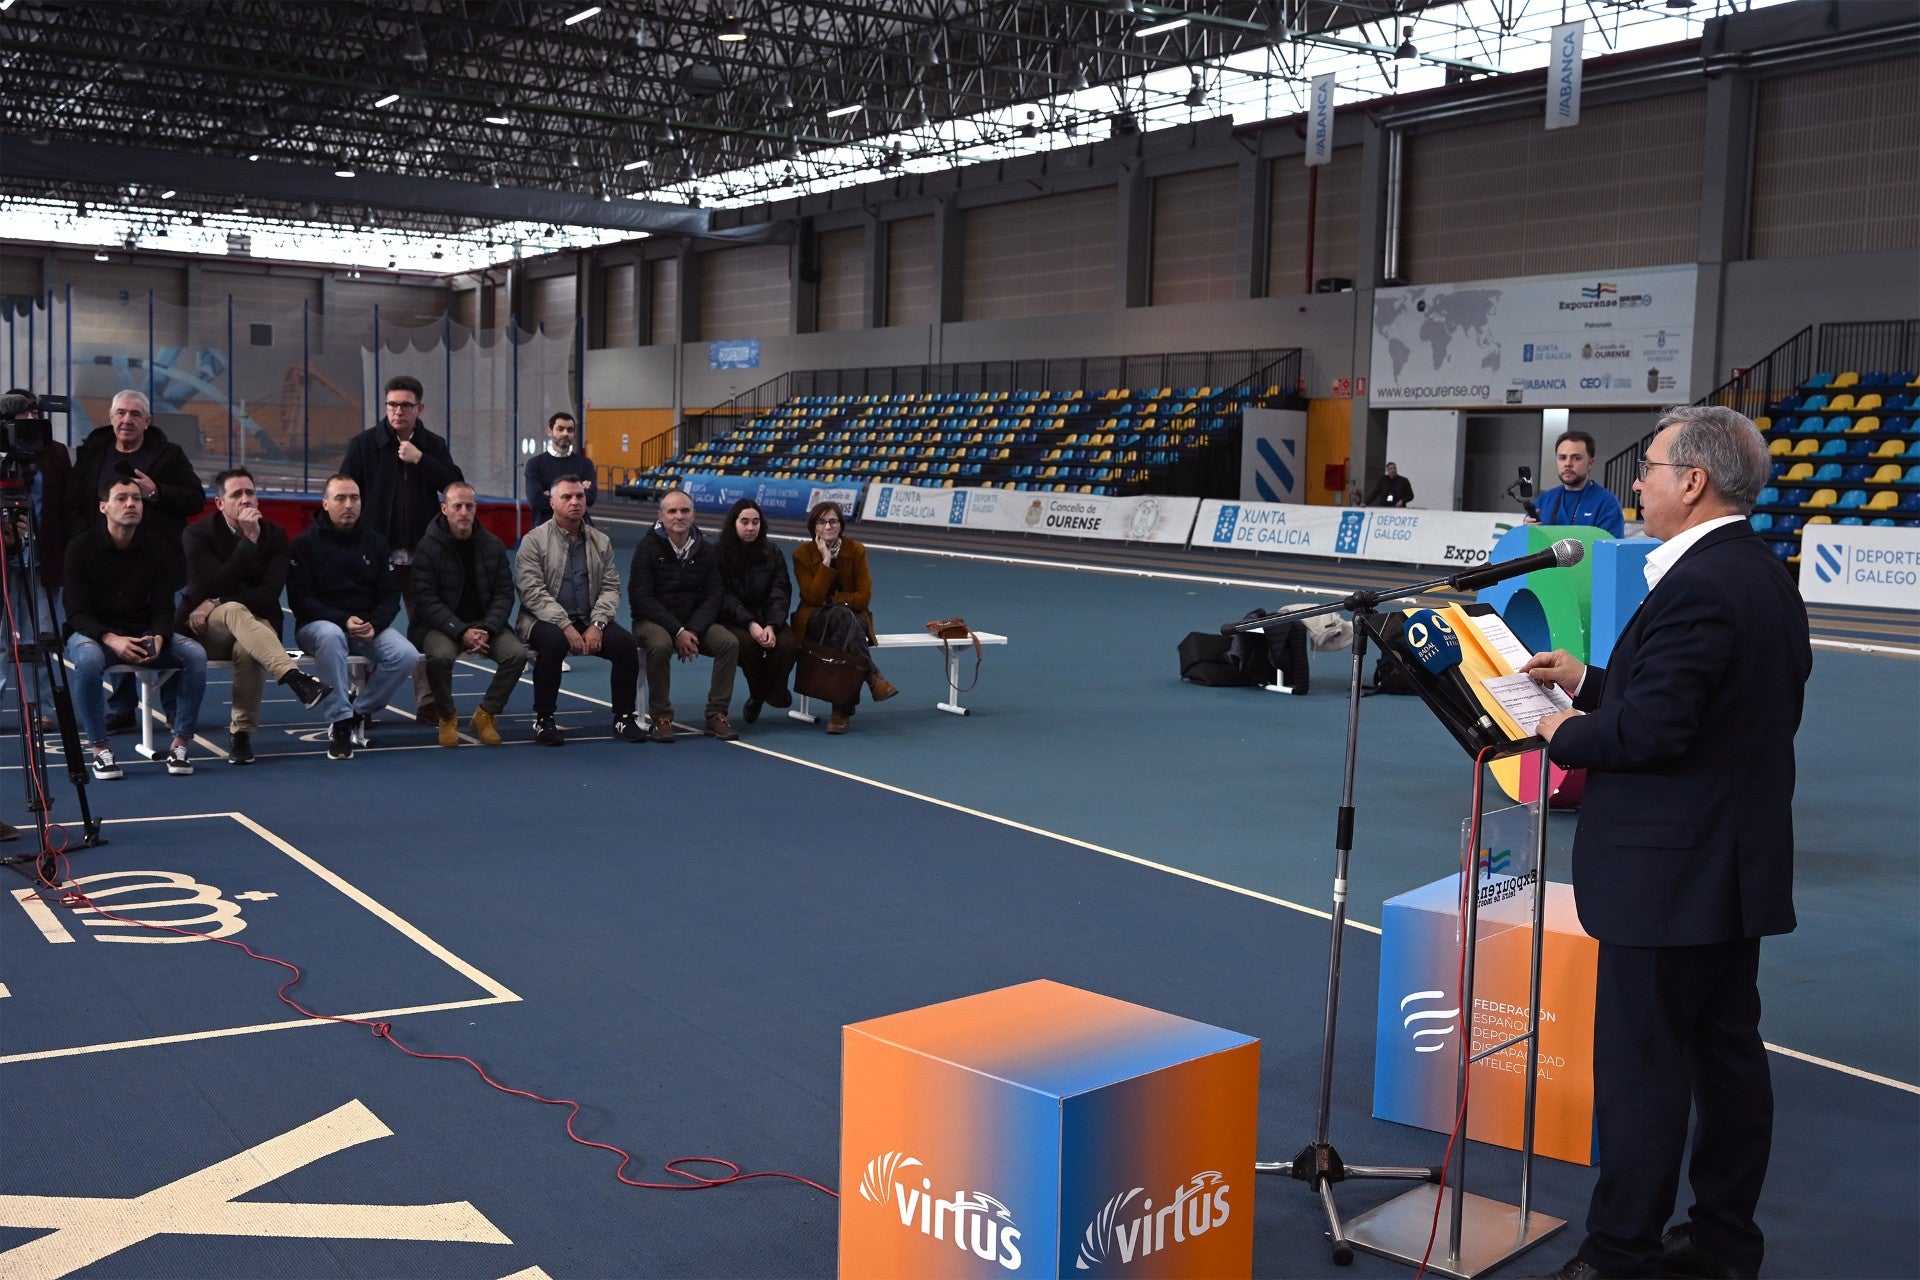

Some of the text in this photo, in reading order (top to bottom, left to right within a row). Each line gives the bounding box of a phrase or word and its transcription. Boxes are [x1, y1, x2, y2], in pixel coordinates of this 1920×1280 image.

[1558, 299, 1617, 311] Expourense
[1594, 350, 1631, 359] OURENSE
[1377, 385, 1490, 400] www.expourense.org
[893, 490, 921, 503] XUNTA
[890, 504, 936, 519] DE GALICIA
[1050, 500, 1097, 514] Concello de
[1046, 514, 1102, 531] OURENSE
[1241, 508, 1286, 525] XUNTA
[1376, 515, 1419, 527] DEPORTE
[1236, 526, 1311, 546] DE GALICIA
[1374, 528, 1412, 541] GALEGO
[1443, 545, 1491, 564] Expo
[1855, 568, 1917, 586] GALEGO
[1474, 998, 1556, 1022] FEDERACÓN
[1473, 1012, 1529, 1032] ESPAÑOL
[1471, 1057, 1553, 1080] NTELECTAL
[894, 1177, 1023, 1271] virtus
[1115, 1180, 1231, 1265] virtus
